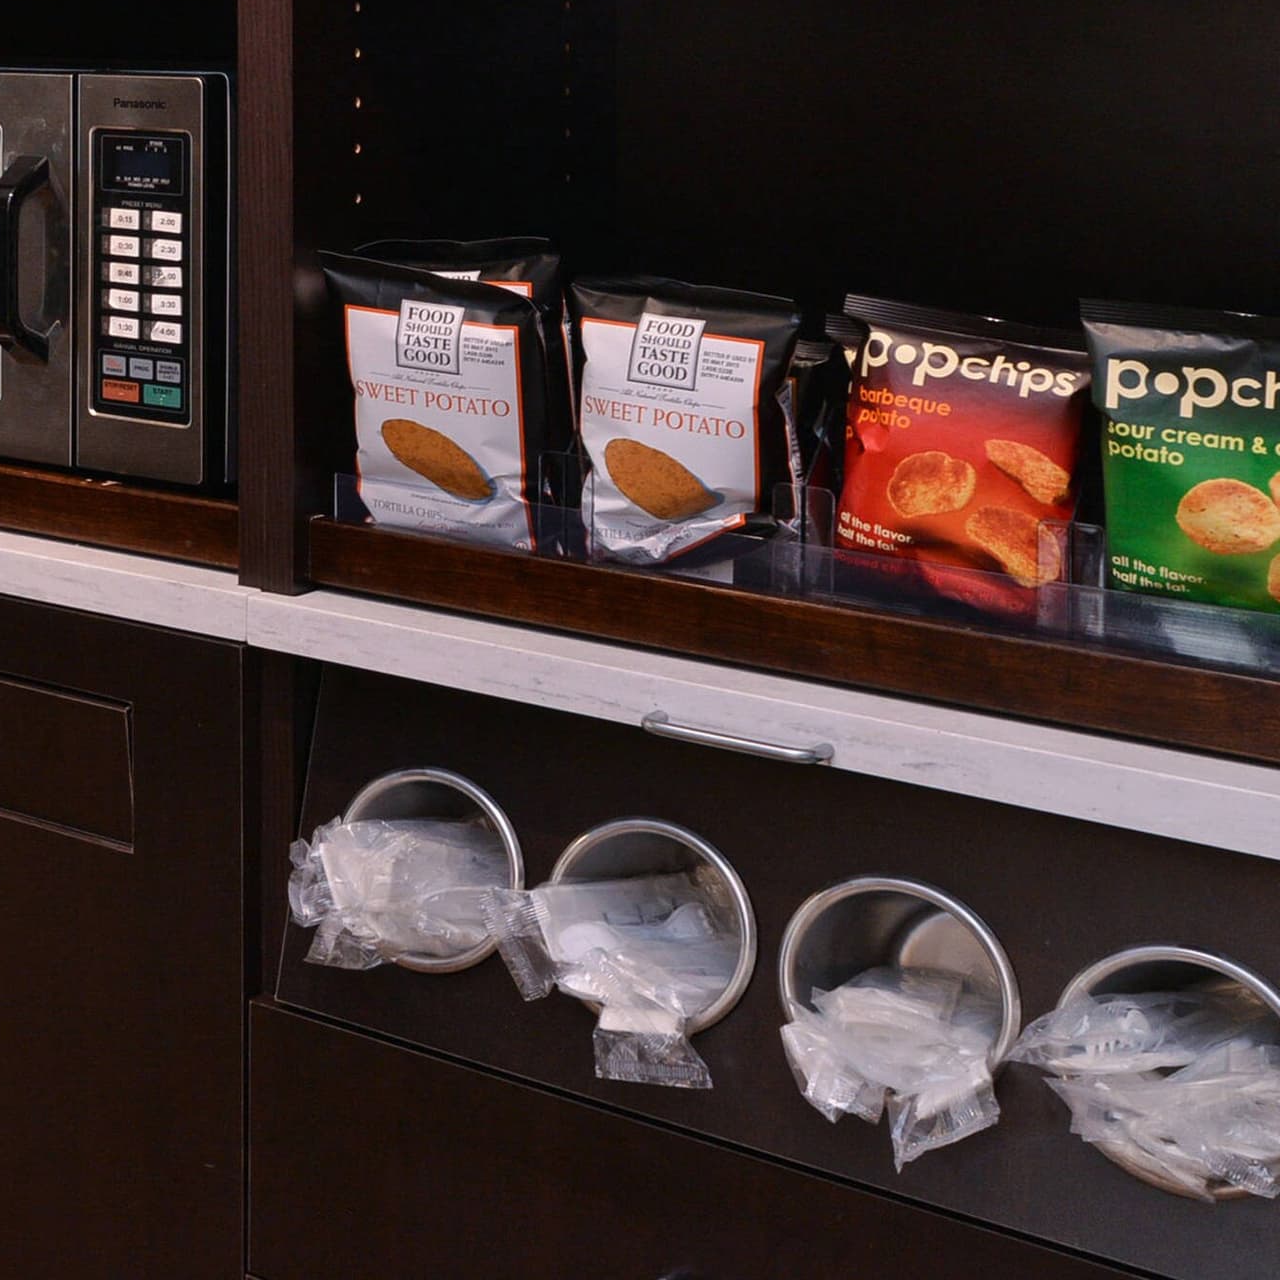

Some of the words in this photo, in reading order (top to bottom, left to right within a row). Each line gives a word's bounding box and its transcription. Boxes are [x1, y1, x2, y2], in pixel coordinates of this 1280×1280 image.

[113, 97, 167, 111] Panasonic
[407, 306, 455, 326] FOOD
[405, 322, 453, 337] SHOULD
[644, 320, 696, 338] FOOD
[403, 333, 452, 352] TASTE
[641, 334, 692, 350] SHOULD
[403, 347, 452, 367] GOOD
[639, 346, 690, 365] TASTE
[637, 362, 687, 382] GOOD
[356, 379, 419, 406] SWEET
[424, 390, 511, 418] POTATO
[859, 384, 952, 417] barbeque
[584, 394, 649, 424] SWEET
[652, 403, 746, 440] POTATO
[1107, 420, 1156, 441] sour
[1160, 428, 1247, 453] cream
[1250, 436, 1269, 455] &
[1107, 439, 1185, 467] potato
[852, 514, 872, 532] the
[873, 519, 915, 545] flavor.
[855, 529, 876, 547] the
[1111, 553, 1130, 566] all
[1131, 558, 1154, 573] the
[1156, 563, 1208, 587] flavor.
[1111, 567, 1137, 587] half
[1138, 573, 1162, 592] the
